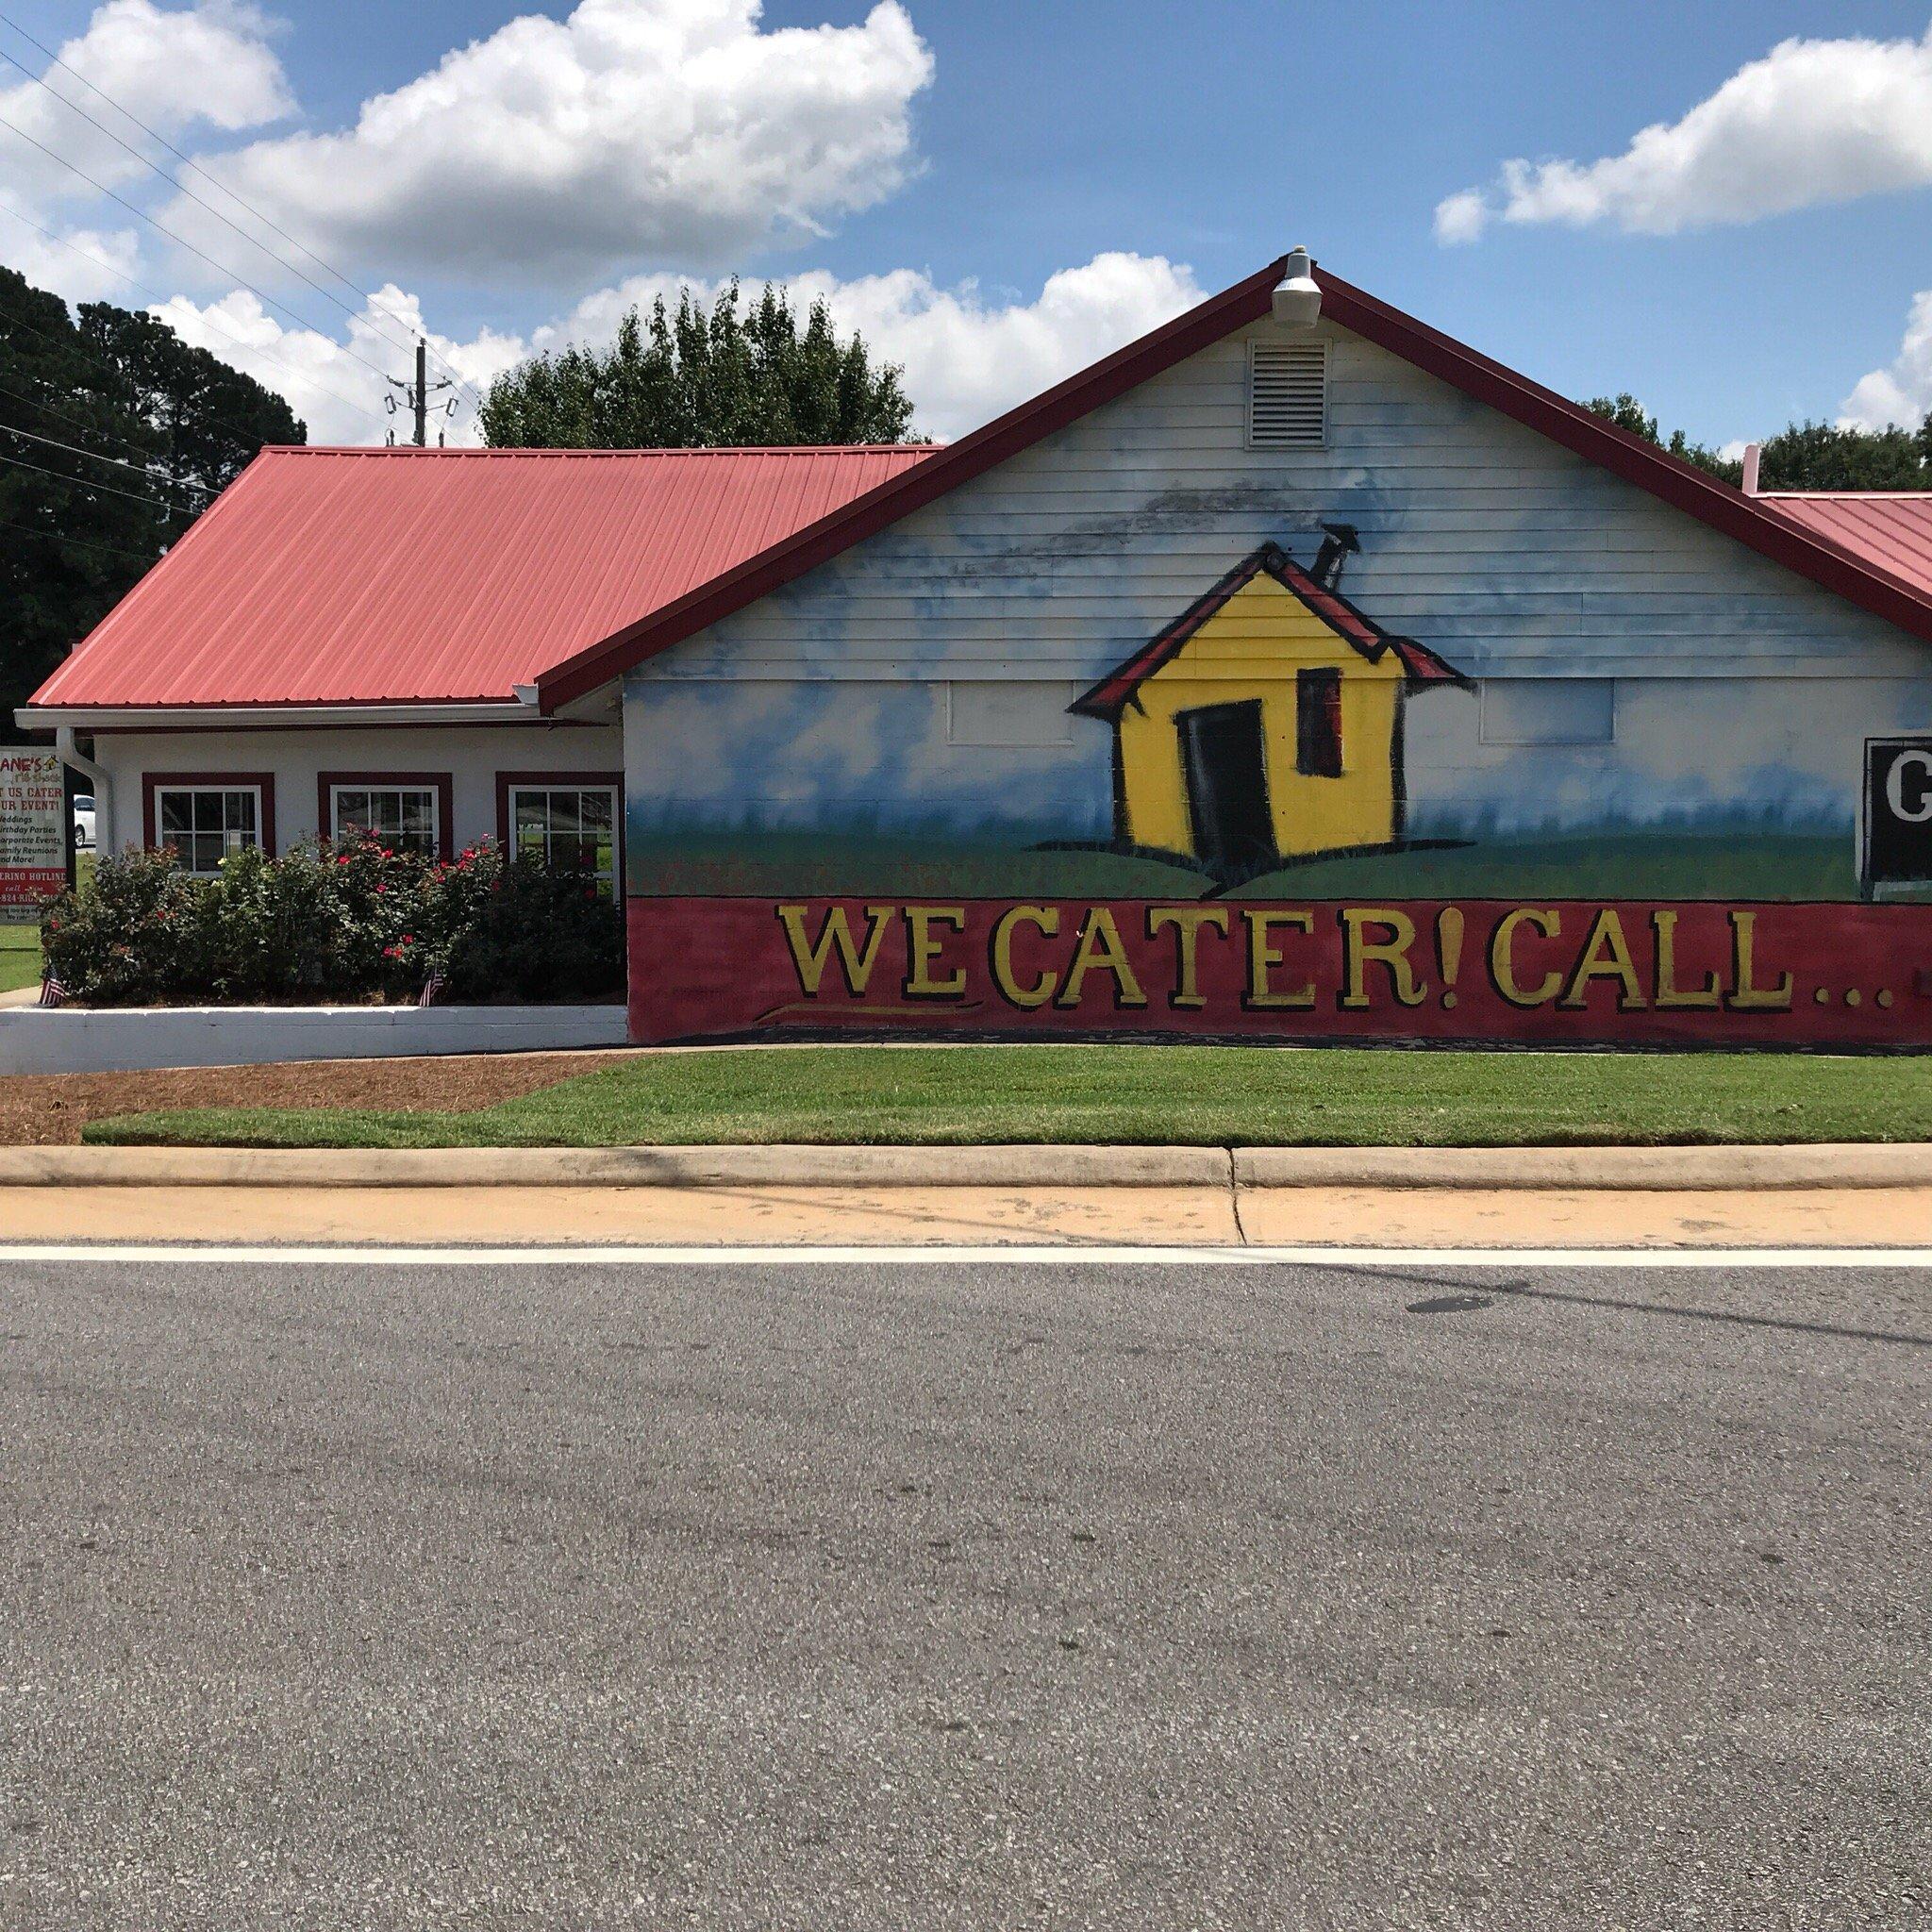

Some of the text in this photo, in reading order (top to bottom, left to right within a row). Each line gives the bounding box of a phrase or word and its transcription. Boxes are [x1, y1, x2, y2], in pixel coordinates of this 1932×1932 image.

[8, 787, 23, 798] US
[27, 787, 62, 798] CATER
[21, 800, 59, 810] EVENT!
[29, 825, 57, 834] Parties
[11, 855, 35, 863] More!
[29, 872, 66, 881] HOTLINE
[775, 905, 968, 1002] WE
[988, 905, 1464, 1011] CATER!
